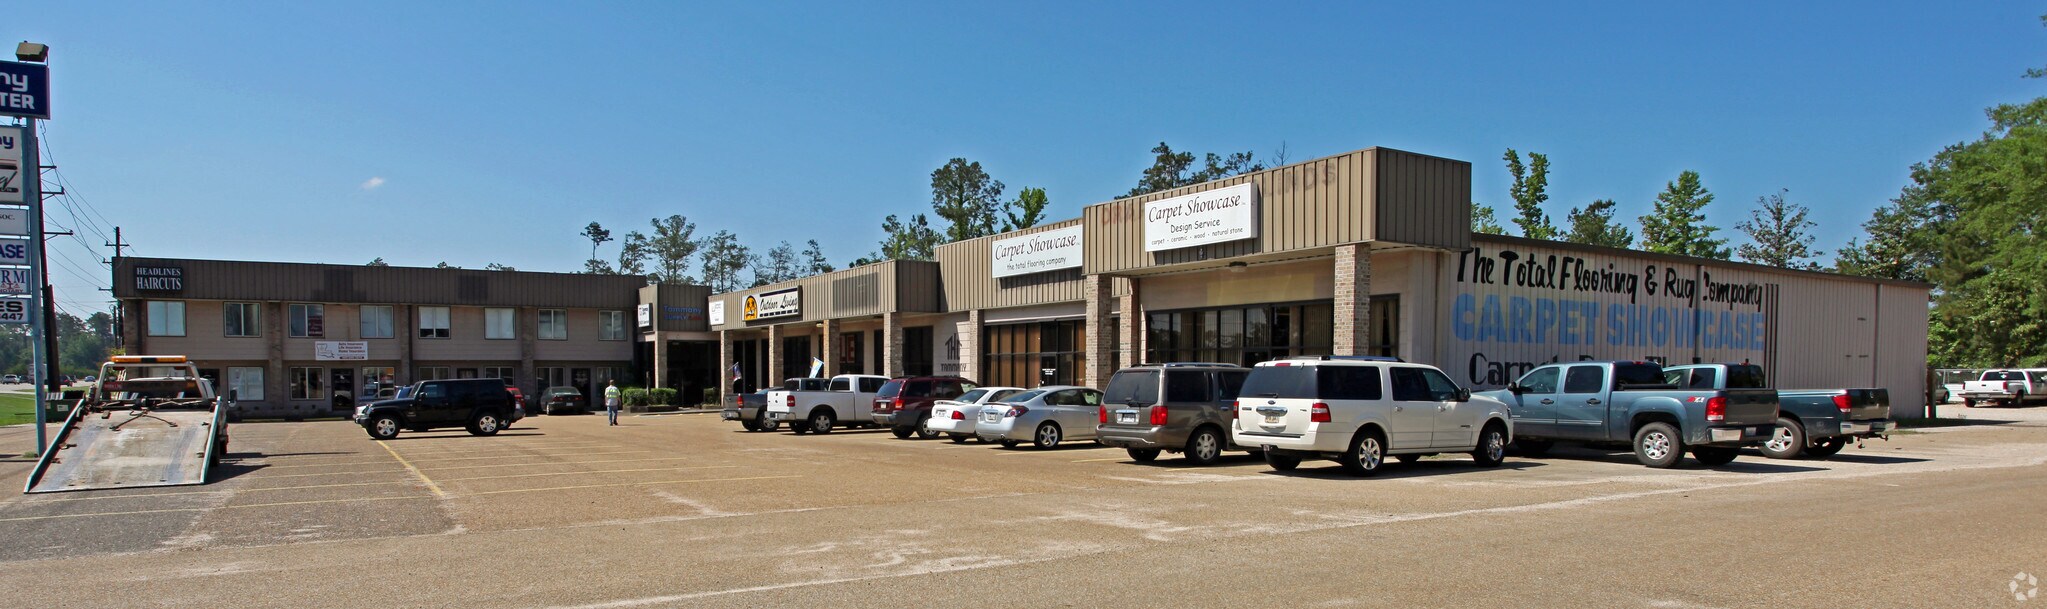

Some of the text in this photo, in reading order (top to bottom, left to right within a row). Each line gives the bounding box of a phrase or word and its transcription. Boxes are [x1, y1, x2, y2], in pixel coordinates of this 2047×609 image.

[0, 92, 35, 109] TER
[1148, 194, 1241, 223] Carpet Showcase
[1170, 218, 1221, 234] Design Service
[1151, 238, 1165, 246] carpet
[1211, 228, 1229, 236] natural
[995, 235, 1077, 261] Carpet Showcase
[1015, 261, 1026, 269] total
[1027, 259, 1046, 268] flooring
[1045, 256, 1067, 266] company
[136, 267, 181, 276] HEADLINES
[1456, 247, 1495, 285] The
[1499, 250, 1557, 290] Total
[1559, 255, 1639, 304] Flooring
[1644, 264, 1658, 296] &
[1663, 267, 1695, 308] Rug
[136, 277, 182, 290] HAIRCUTS
[760, 294, 798, 311] Outdoor Living
[1452, 293, 1765, 351] CARPET SHOWCASE
